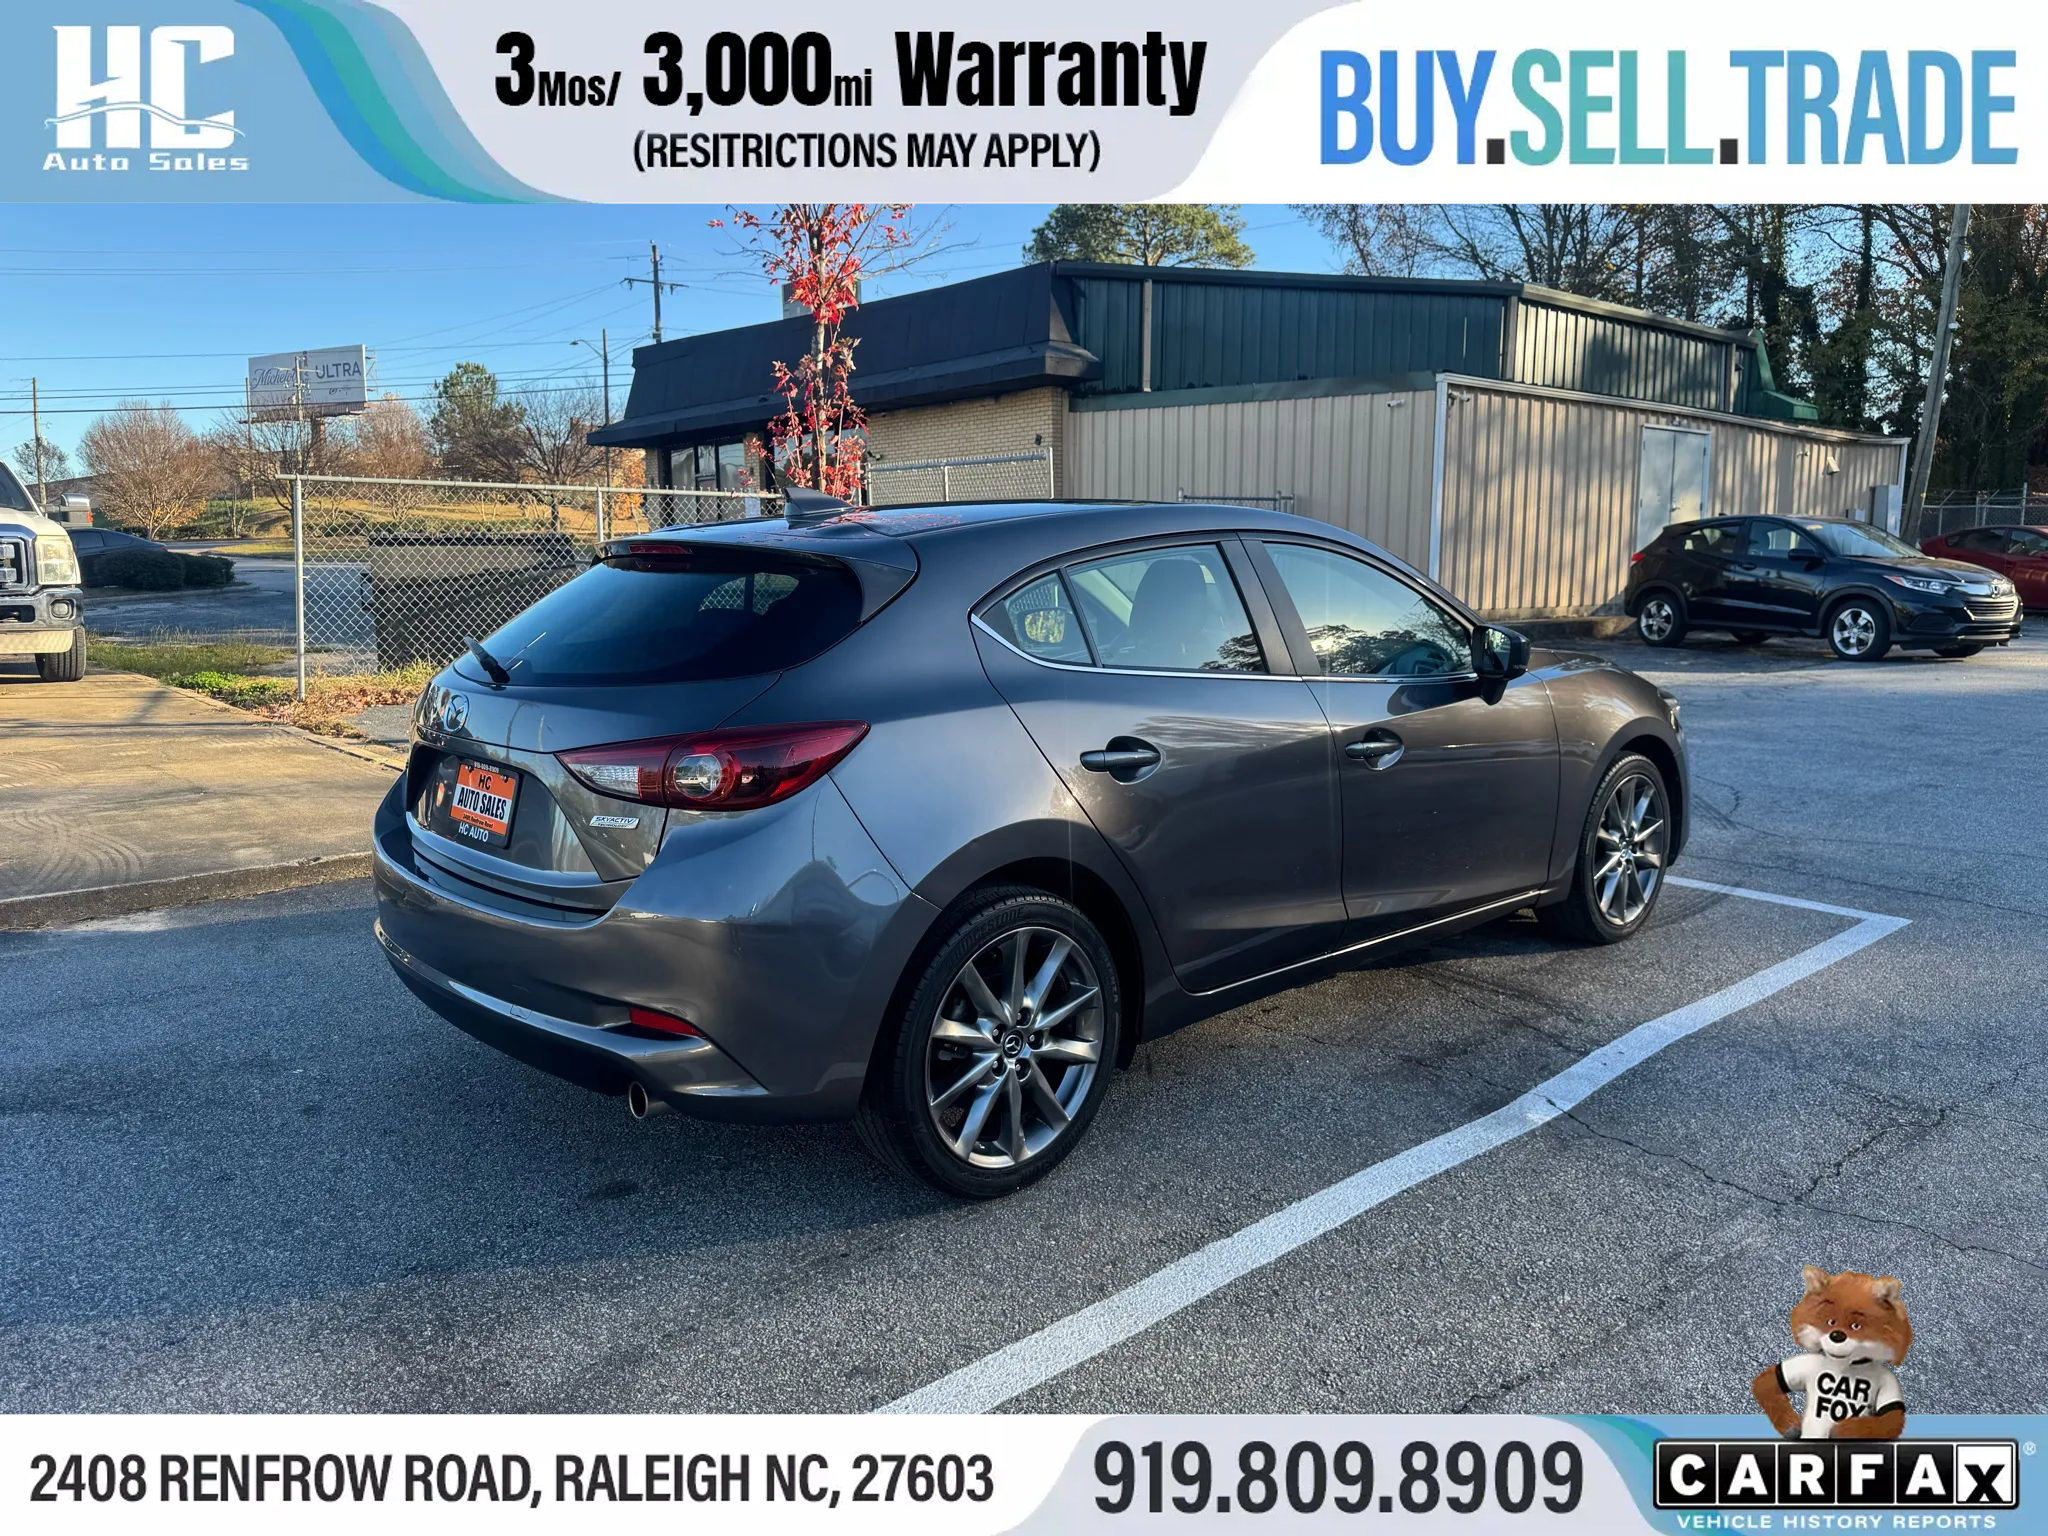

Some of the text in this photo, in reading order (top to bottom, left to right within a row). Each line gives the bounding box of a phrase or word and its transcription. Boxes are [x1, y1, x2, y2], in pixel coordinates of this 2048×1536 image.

[315, 361, 361, 379] ULTRA
[479, 774, 492, 790] HC
[457, 787, 507, 821] AUTO SALES
[595, 816, 634, 824] SKYACTIV
[458, 822, 489, 842] HC AUTO
